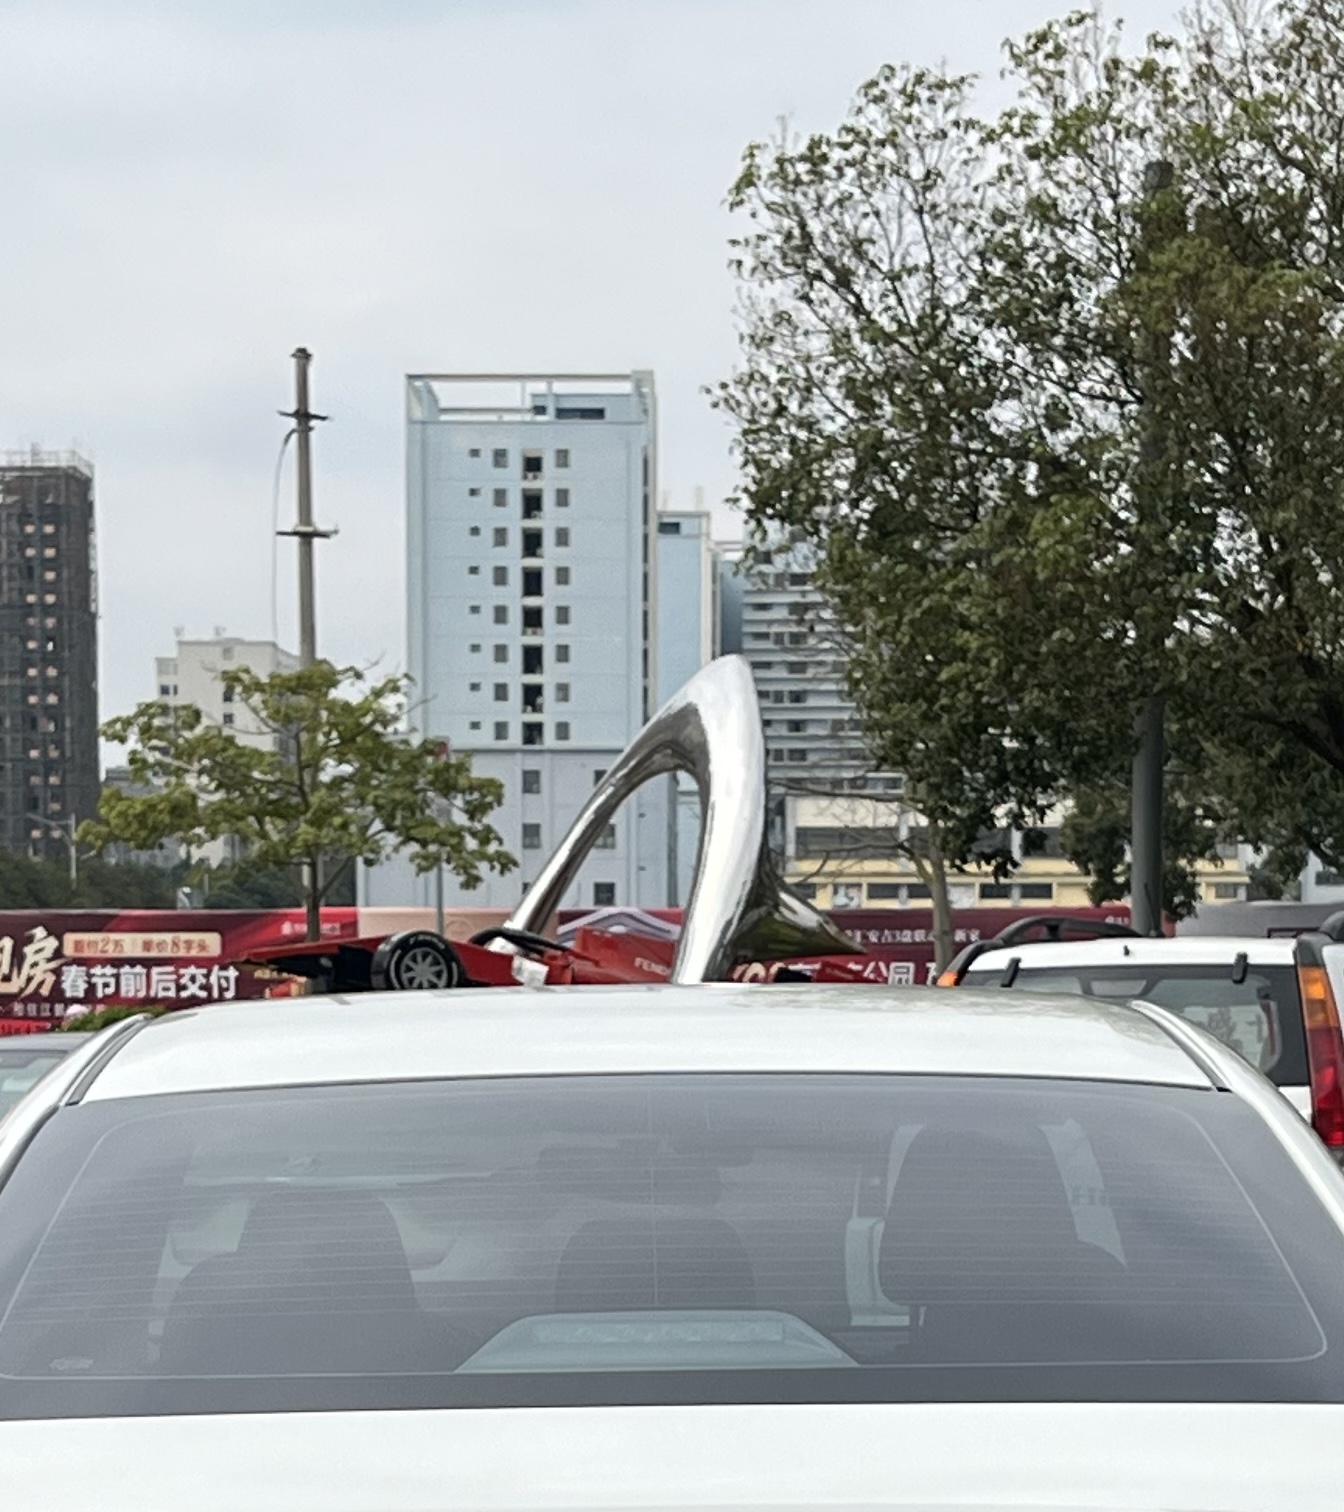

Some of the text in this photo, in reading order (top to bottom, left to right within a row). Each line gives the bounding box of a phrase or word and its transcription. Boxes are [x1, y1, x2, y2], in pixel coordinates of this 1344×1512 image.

[61, 965, 239, 999] 春节前后交付
